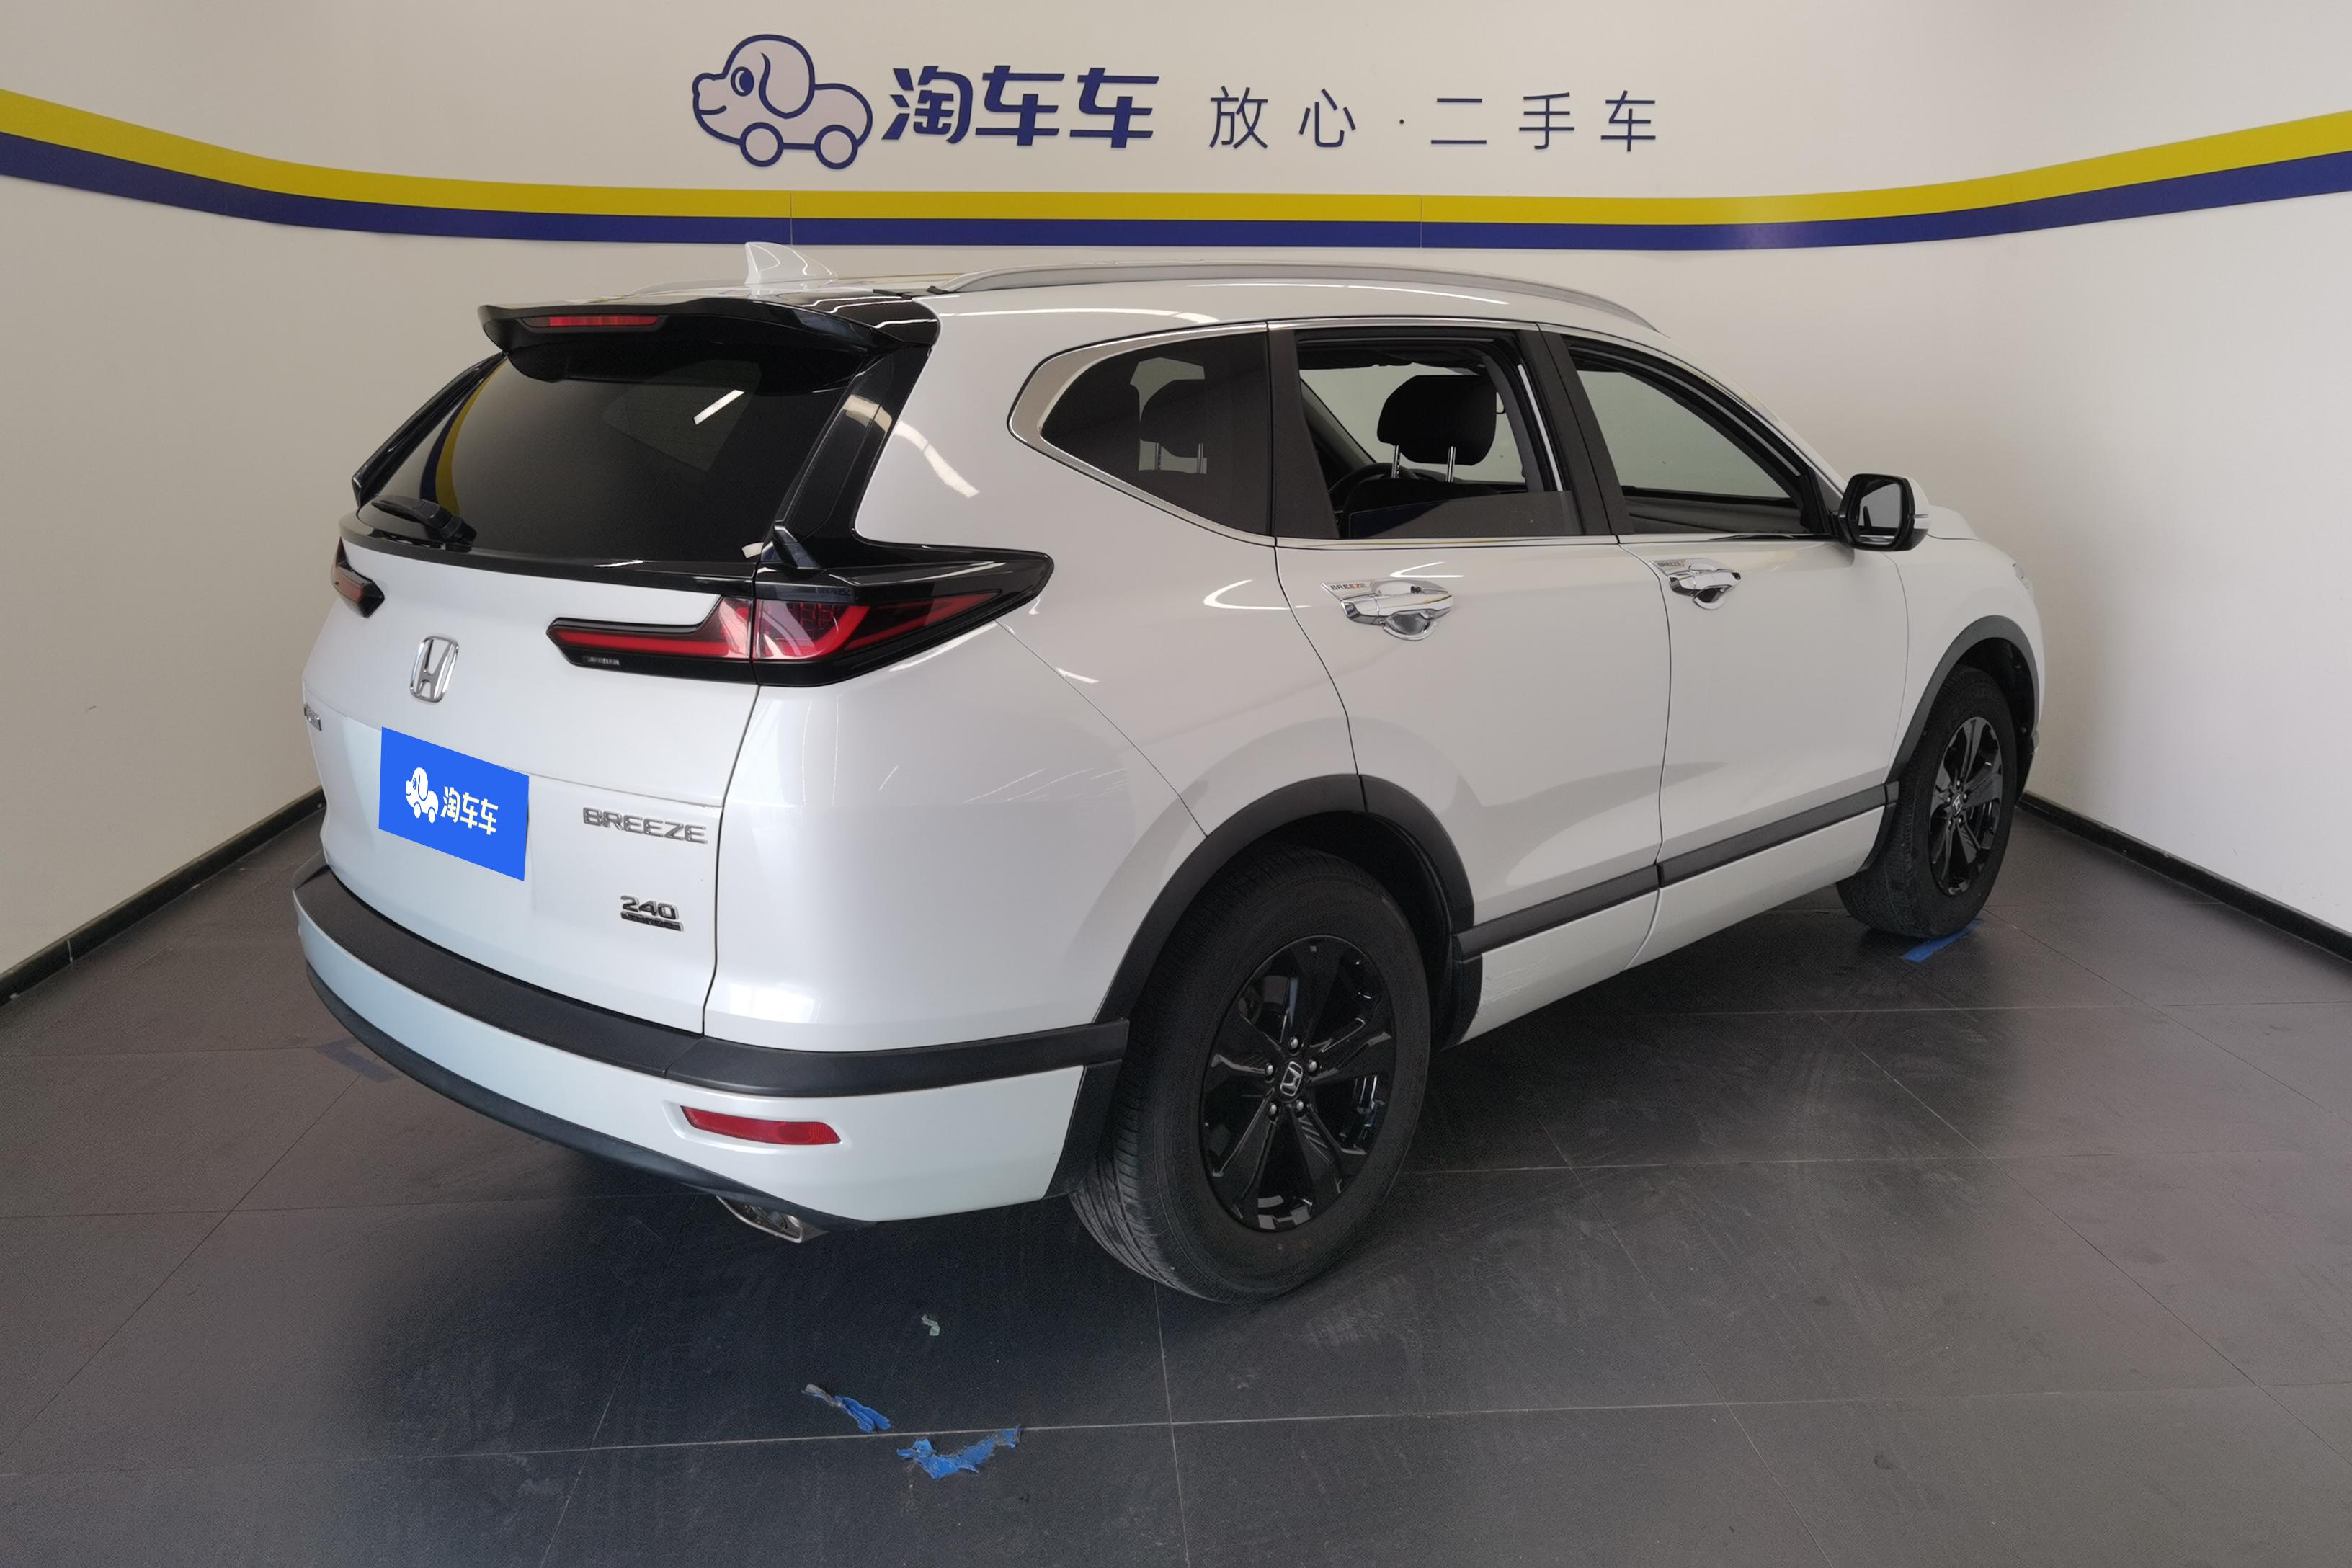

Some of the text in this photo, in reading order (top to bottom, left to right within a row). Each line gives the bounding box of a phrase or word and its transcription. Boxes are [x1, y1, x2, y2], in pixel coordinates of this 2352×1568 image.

[881, 65, 1159, 148] 淘车车
[583, 807, 708, 845] BREEZE
[620, 895, 680, 920] 240
